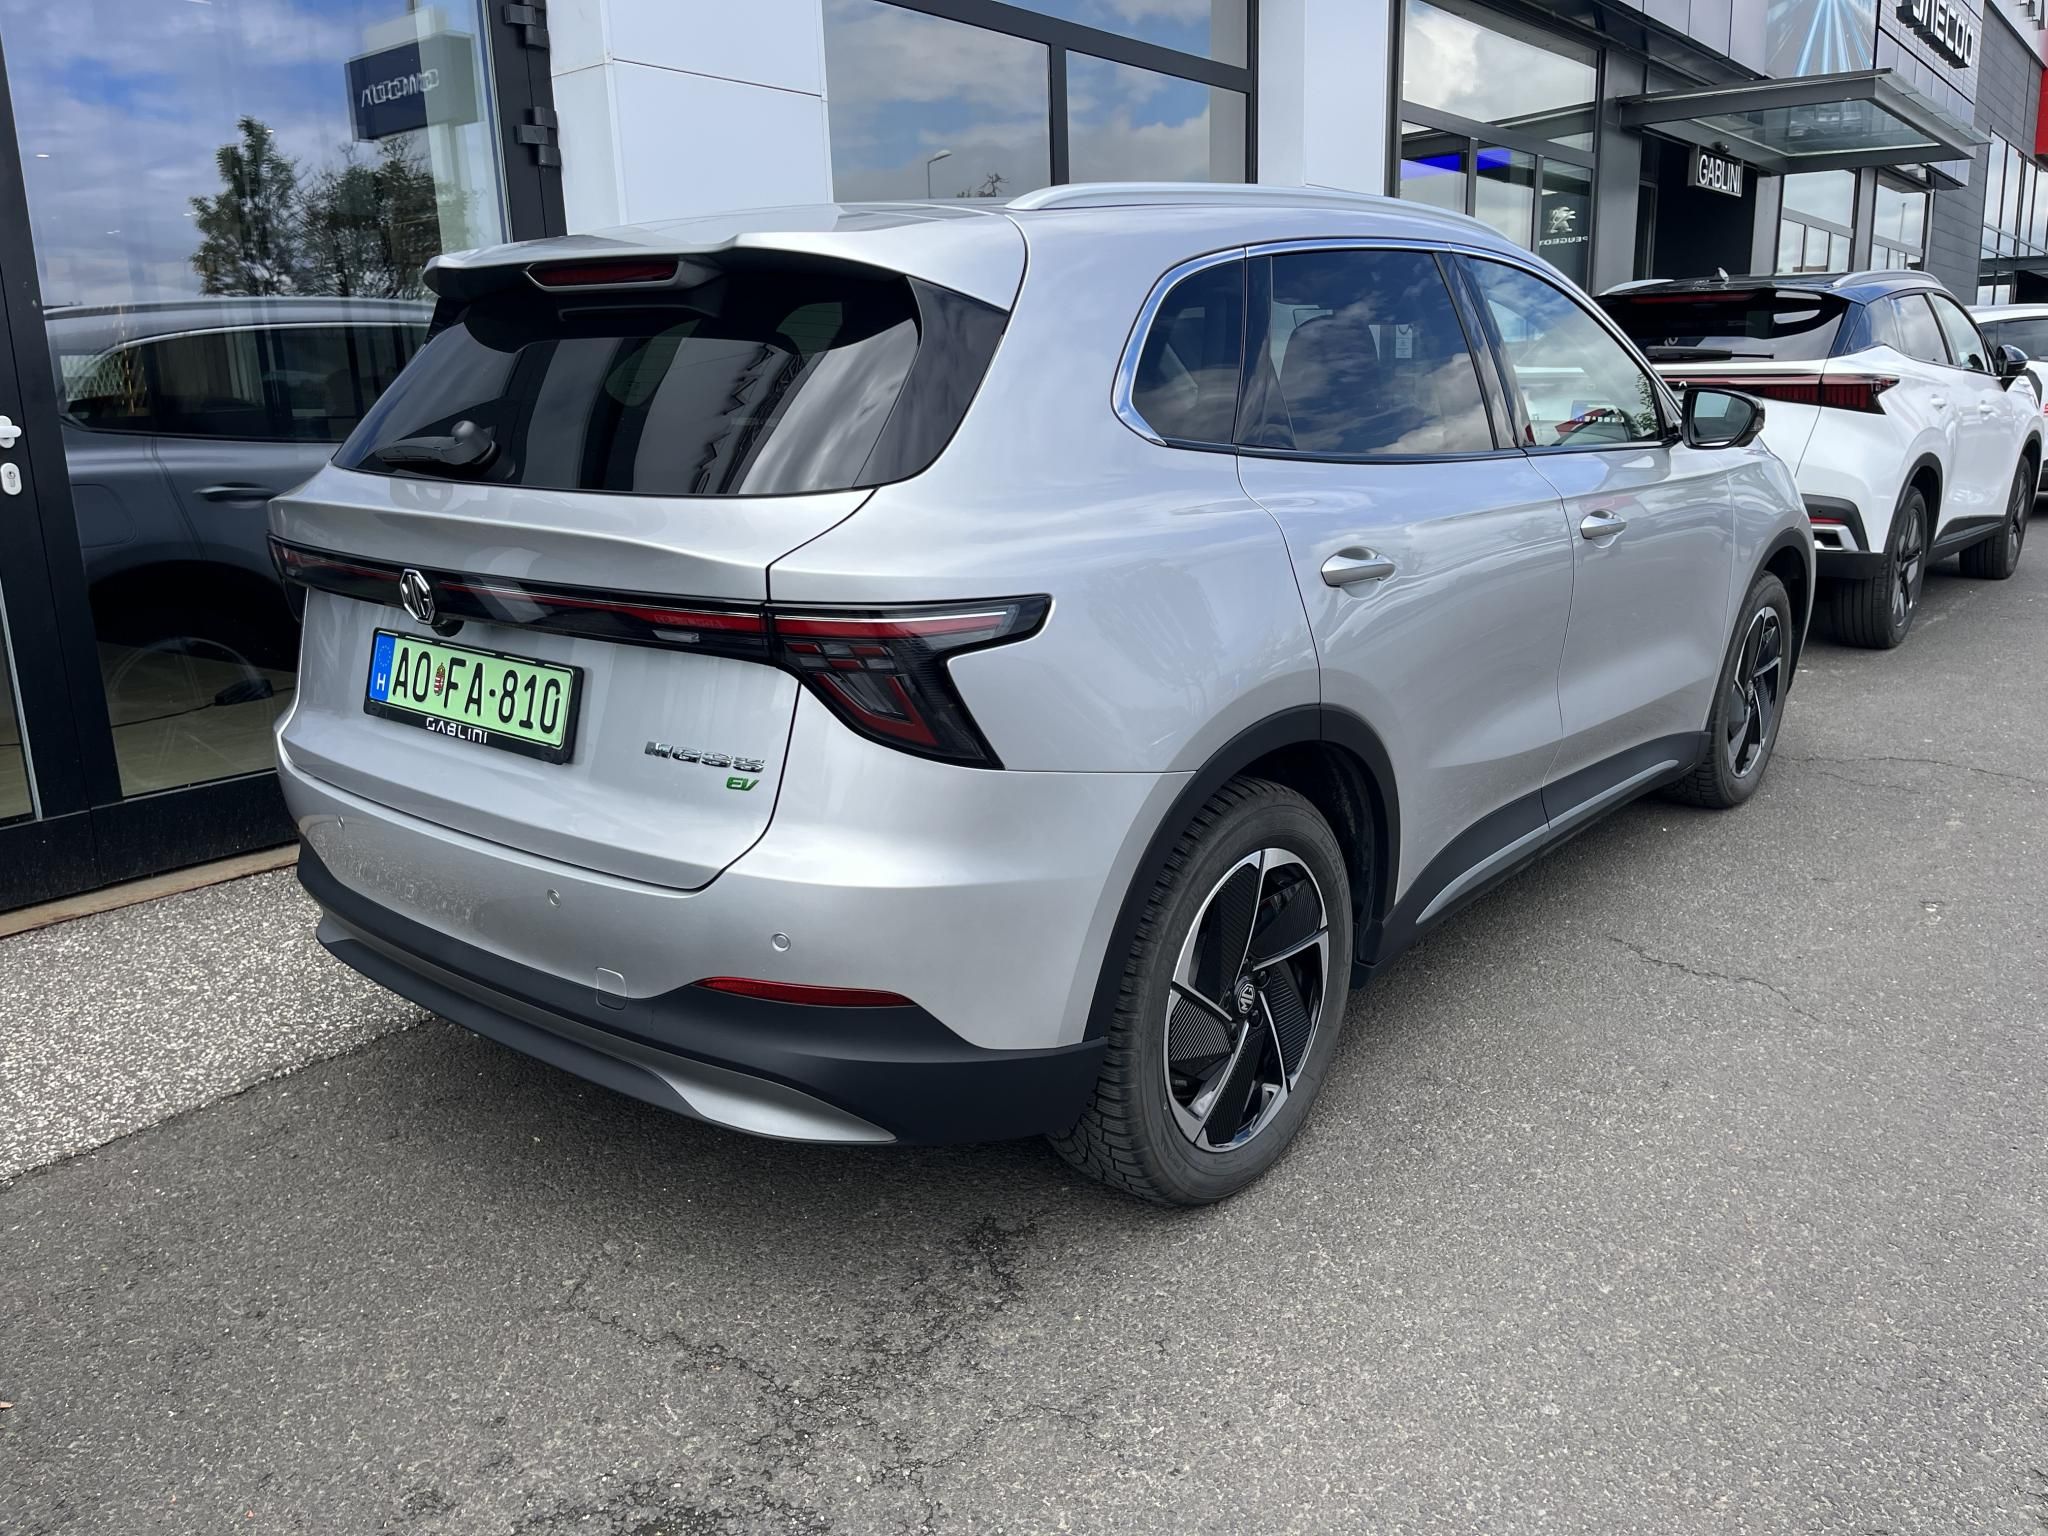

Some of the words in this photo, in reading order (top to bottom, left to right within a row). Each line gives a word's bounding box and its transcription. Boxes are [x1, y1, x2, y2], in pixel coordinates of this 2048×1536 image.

[1699, 154, 1741, 194] GABLINI
[426, 717, 488, 744] GABLINI
[726, 776, 760, 791] EV
